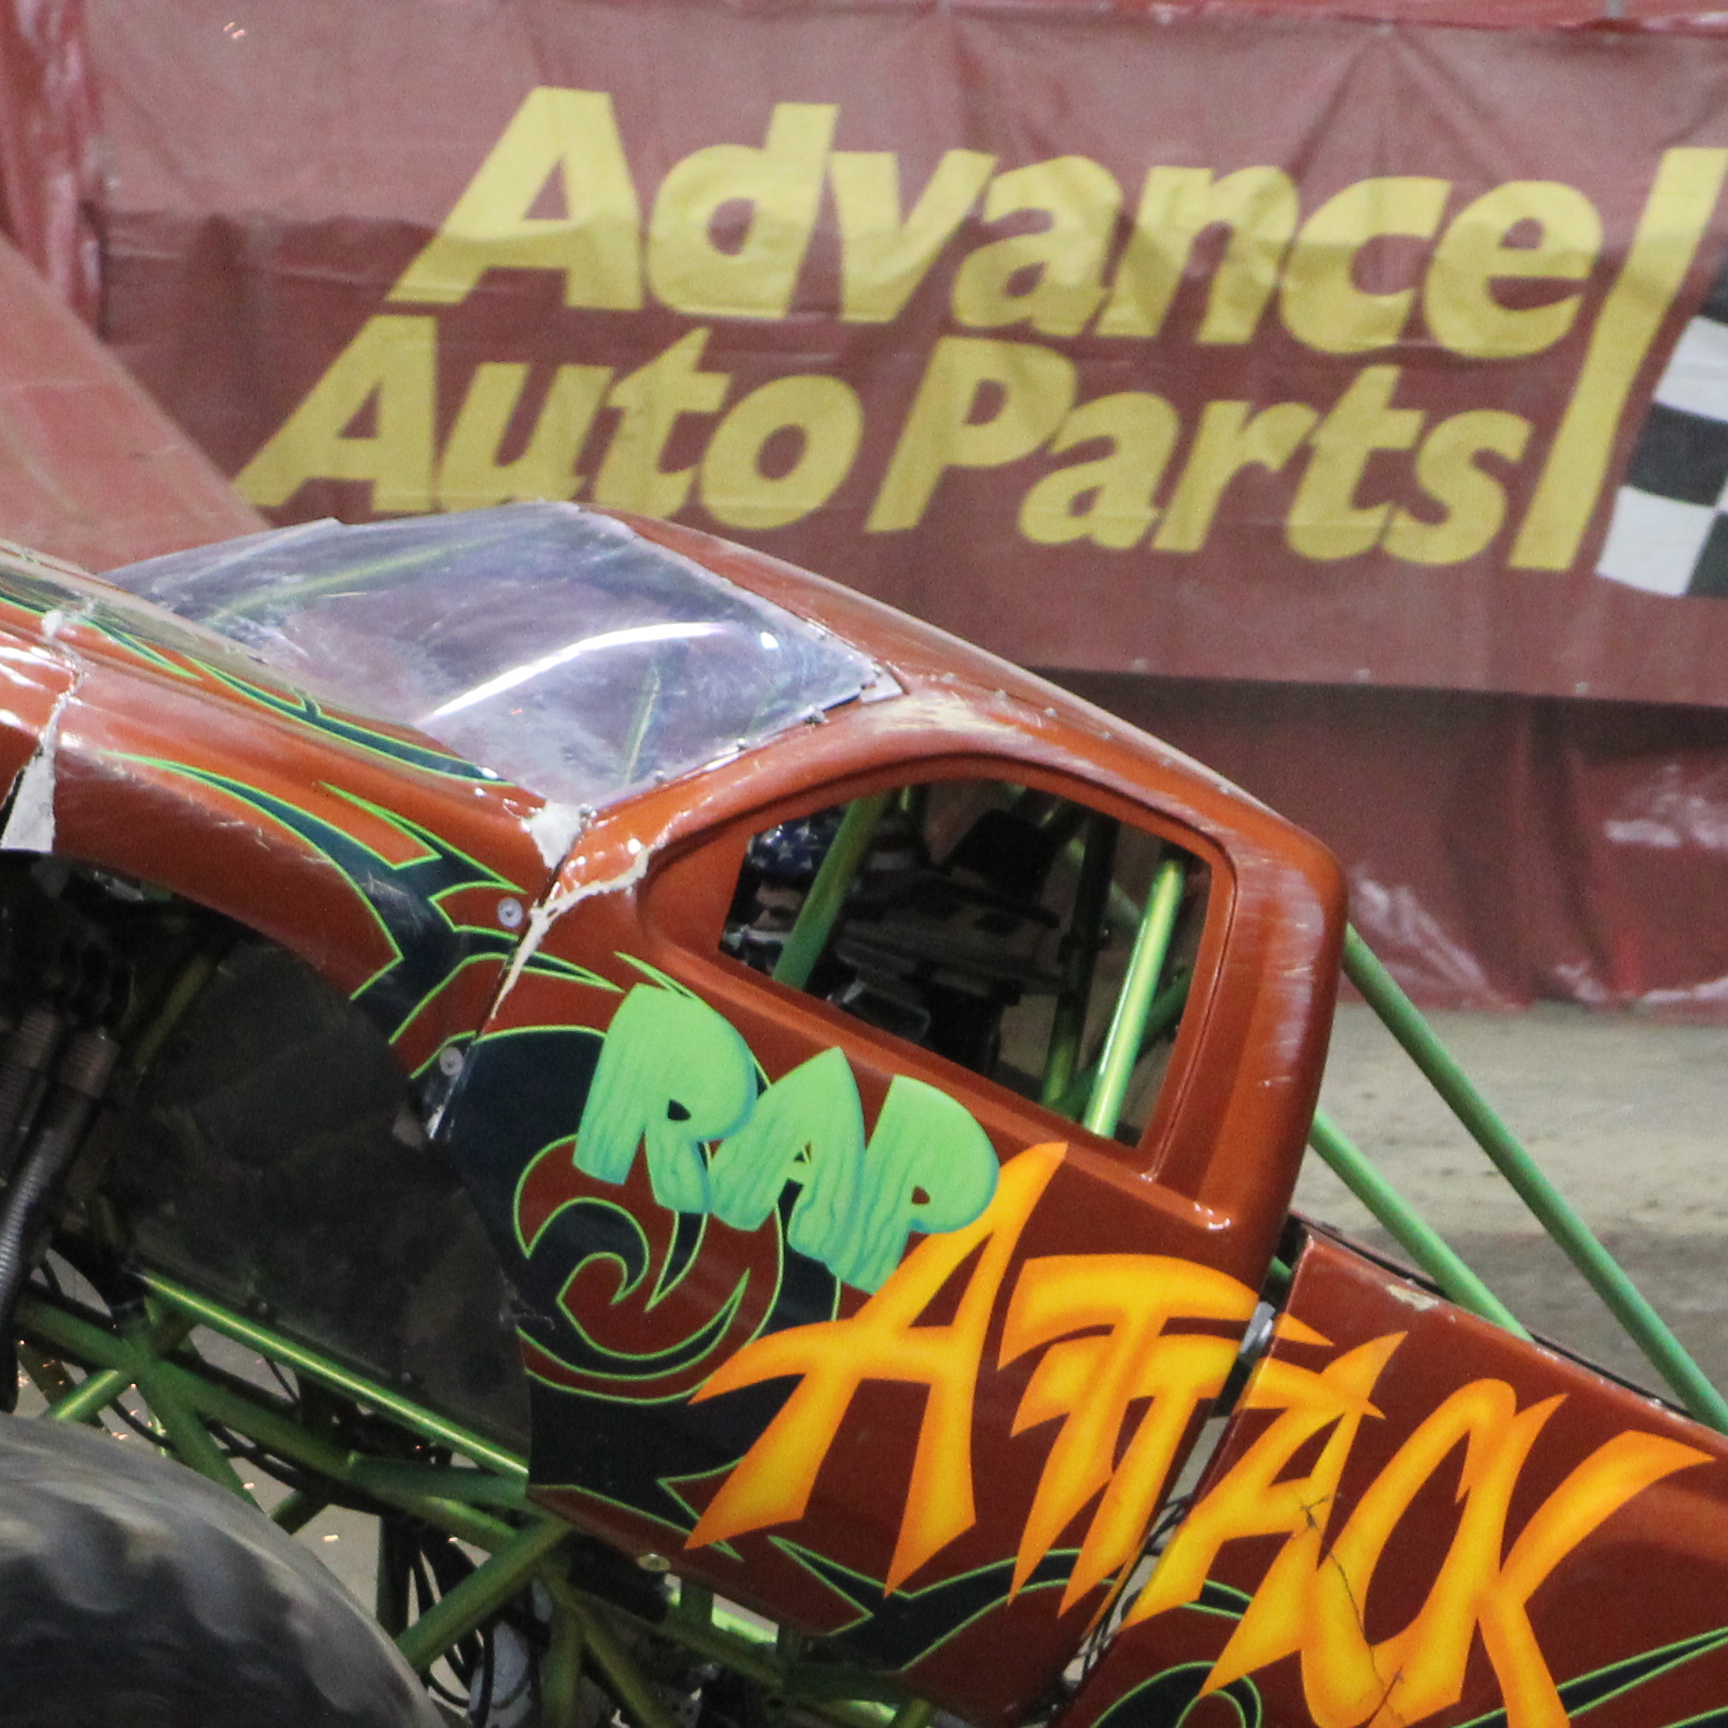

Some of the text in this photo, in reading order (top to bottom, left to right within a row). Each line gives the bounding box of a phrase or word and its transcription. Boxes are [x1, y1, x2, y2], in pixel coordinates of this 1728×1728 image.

[385, 85, 1604, 359] Advance
[234, 315, 1528, 568] Auto Parts
[574, 982, 1000, 1292] RAP
